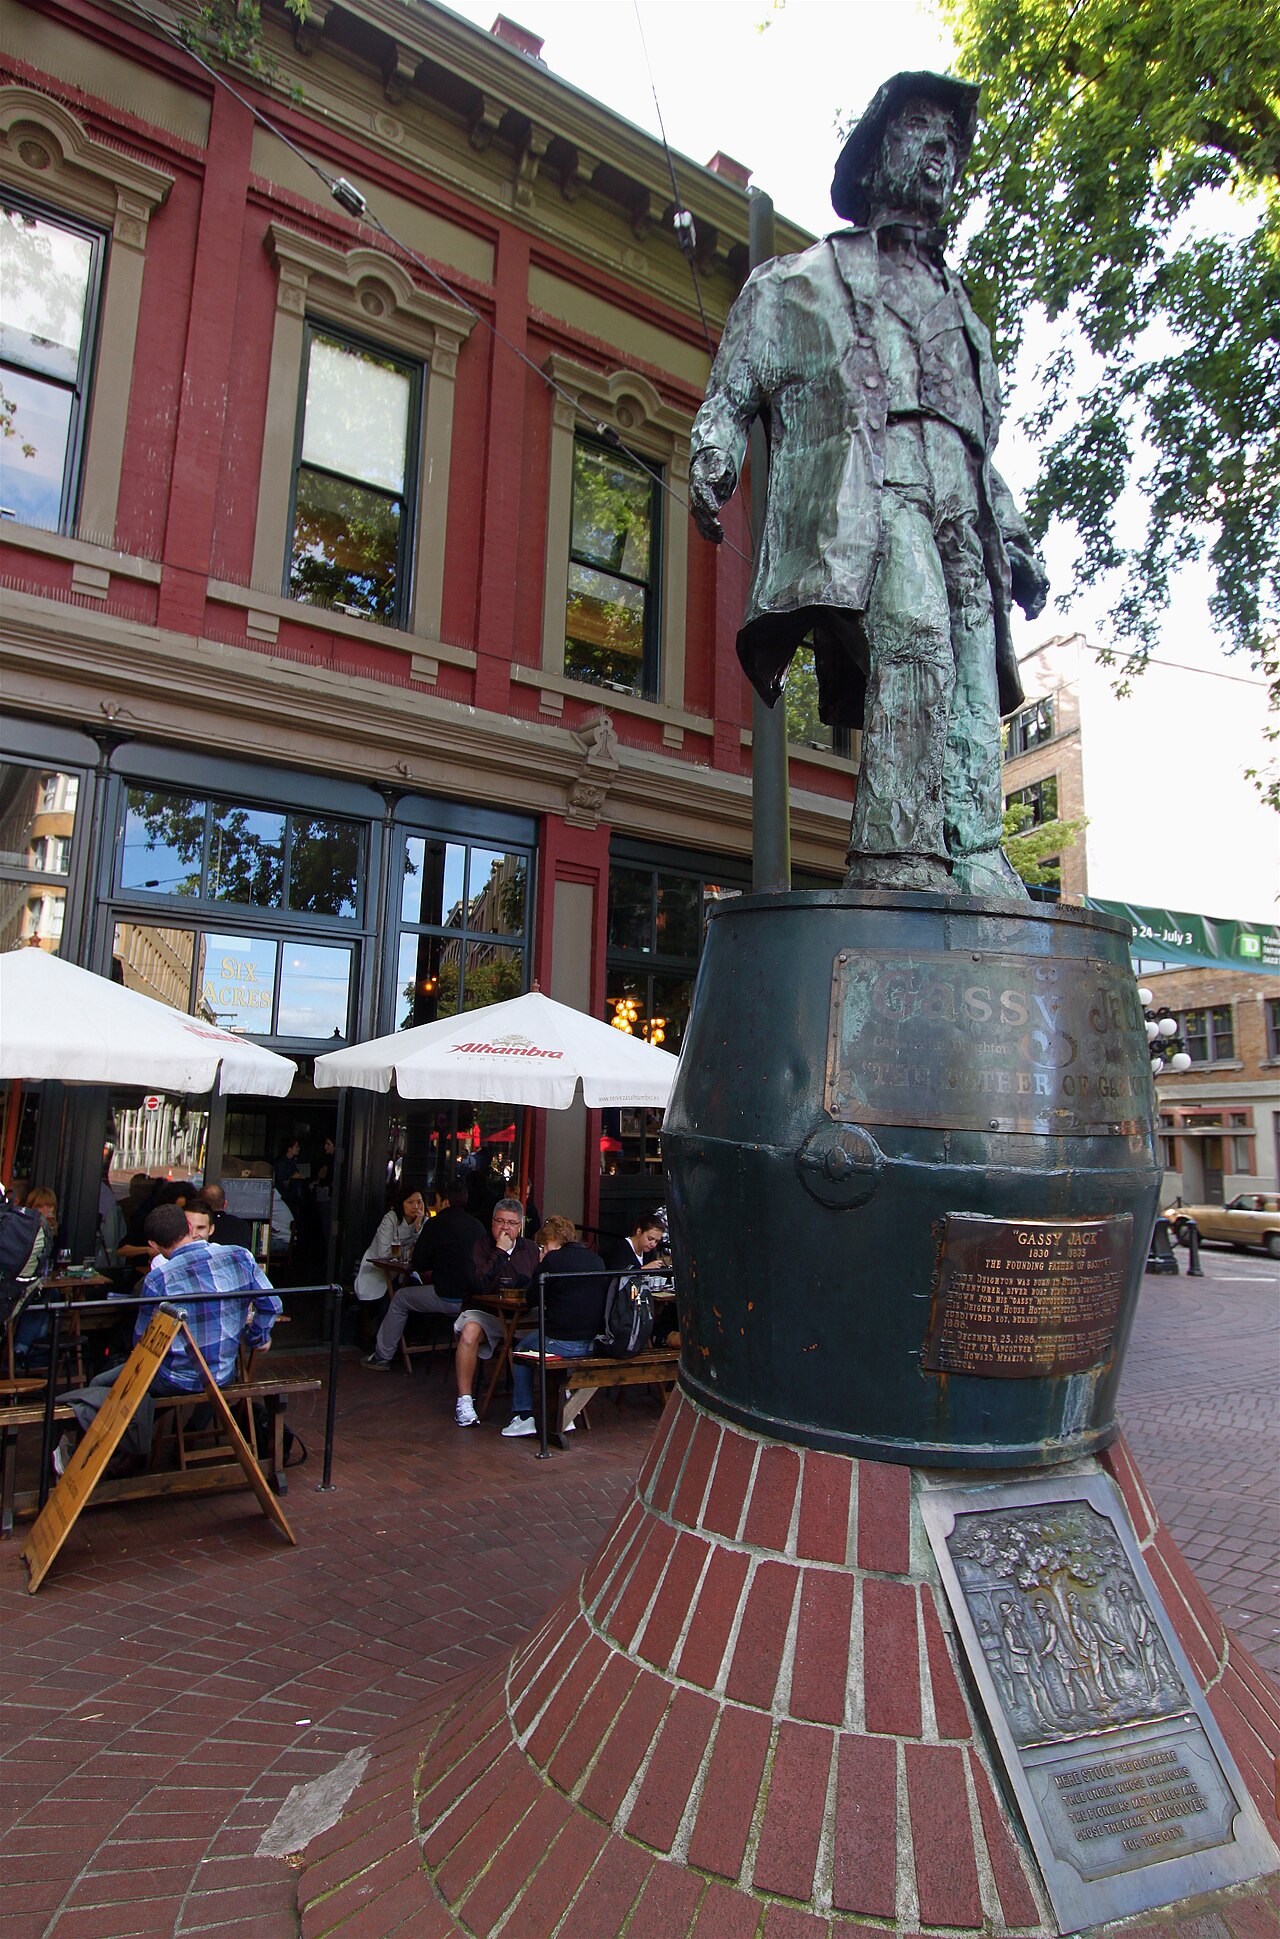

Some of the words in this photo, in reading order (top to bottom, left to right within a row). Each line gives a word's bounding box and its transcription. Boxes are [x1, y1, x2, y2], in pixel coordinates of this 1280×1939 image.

[1139, 925, 1153, 938] 24
[1163, 929, 1184, 946] July
[1185, 932, 1193, 945] 3
[1243, 937, 1259, 953] TD
[221, 956, 257, 982] SIX
[199, 980, 272, 1009] ACRES
[871, 968, 1078, 1070] Gassy
[445, 1042, 564, 1060] Alhambra
[1028, 1249, 1050, 1258] 1830
[985, 1259, 1002, 1270] THE
[1006, 1260, 1044, 1271] FOUNDING
[1048, 1260, 1074, 1271] FATHER
[977, 1273, 1014, 1285] DEIGHTON
[1017, 1277, 1031, 1286] WAS
[979, 1294, 992, 1303] FOR
[995, 1296, 1008, 1304] HIS
[944, 1310, 992, 1322] SUBDIVIDED
[964, 1302, 1000, 1313] DEIGHTON
[1003, 1304, 1025, 1314] HOUSE
[943, 1318, 969, 1329] 1886.
[957, 1330, 997, 1343] DECEMBER
[958, 1340, 977, 1351] CITY
[980, 1343, 989, 1352] OF
[992, 1343, 1032, 1353] VANCOUVER
[963, 1351, 994, 1361] HOWARD
[1054, 1772, 1083, 1789] HERE
[1082, 1764, 1115, 1783] STOOD
[1116, 1762, 1133, 1774] THE
[1133, 1758, 1149, 1771] OLD
[1150, 1751, 1178, 1767] MAPLE
[1062, 1793, 1087, 1807] TREE
[1087, 1785, 1116, 1801] UNDER
[1116, 1778, 1146, 1794] WHOSE
[1147, 1766, 1190, 1787] BRANCHES
[1068, 1811, 1087, 1824] THE
[1088, 1801, 1130, 1819] PIONEERS
[1132, 1796, 1150, 1809] MET
[1150, 1793, 1162, 1804] IN
[1181, 1783, 1199, 1797] AND
[1074, 1825, 1104, 1842] CHOSE
[1104, 1821, 1123, 1835] THE
[1122, 1814, 1147, 1830] NAME
[1122, 1838, 1141, 1851] FOR
[1141, 1832, 1162, 1847] THIS
